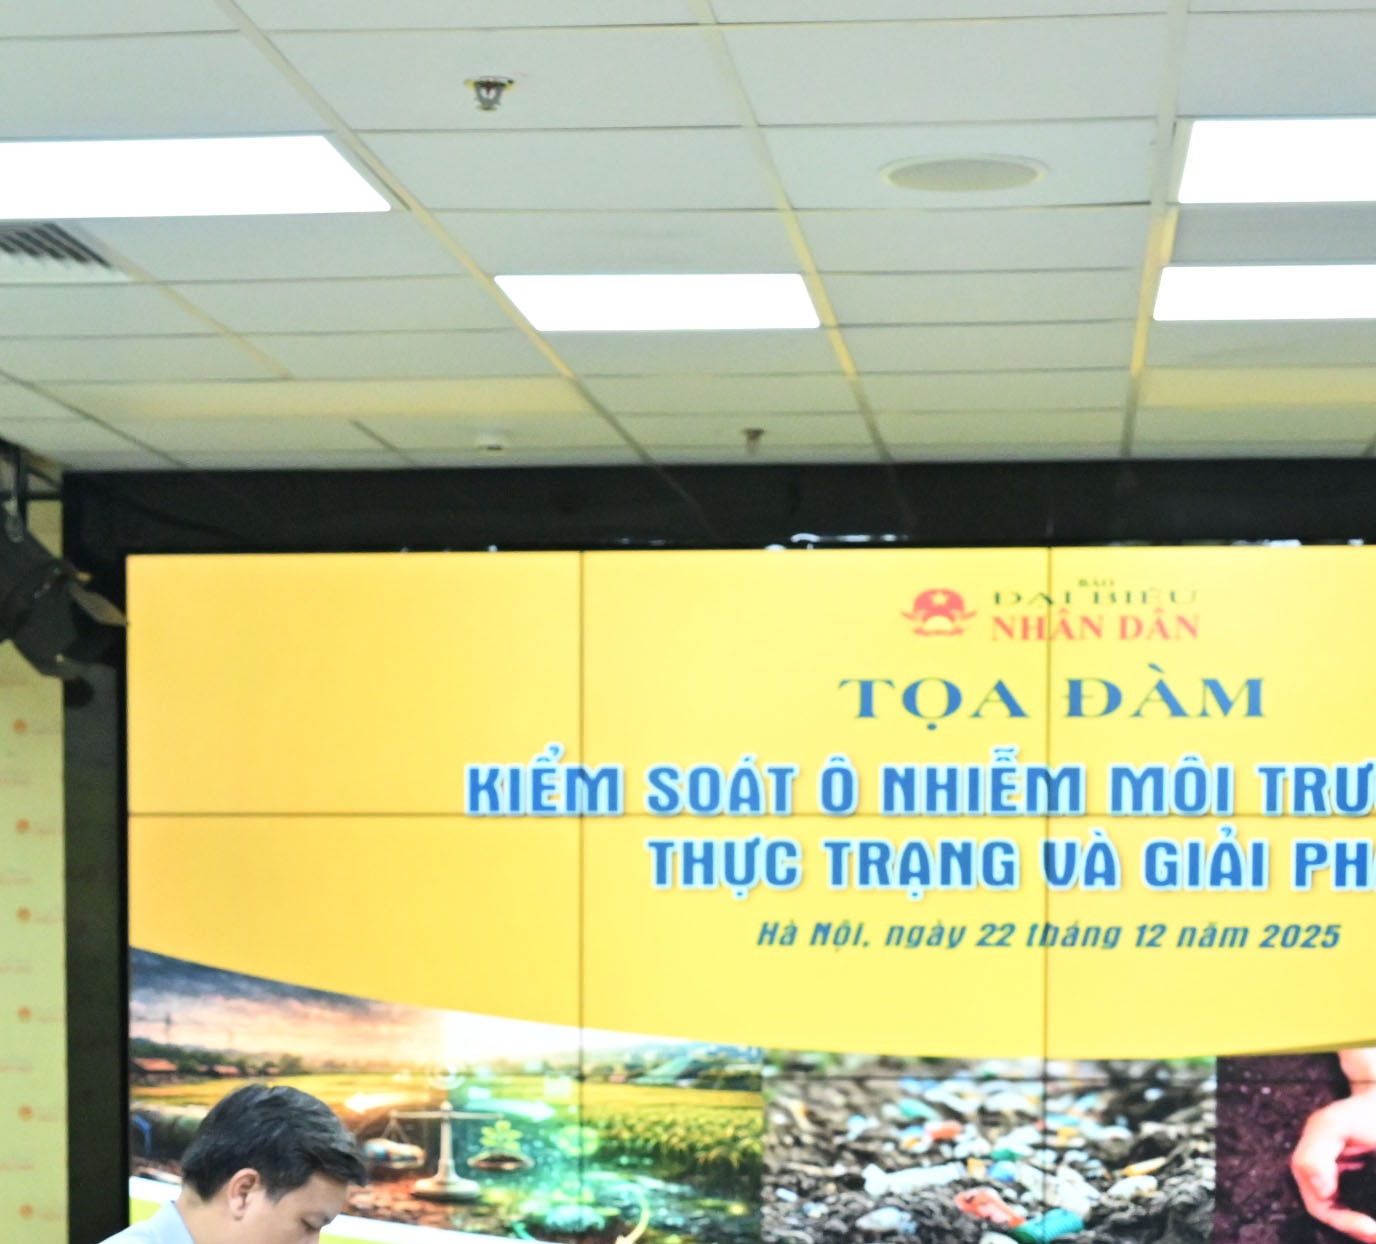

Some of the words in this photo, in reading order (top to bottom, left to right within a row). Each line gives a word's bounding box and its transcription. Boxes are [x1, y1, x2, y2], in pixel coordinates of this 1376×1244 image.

[991, 607, 1104, 642] NHÂN
[1118, 607, 1201, 642] DÂN
[838, 677, 1030, 731] TỌA
[1062, 662, 1266, 719] ĐÀM
[467, 743, 622, 815] KIỂM
[647, 755, 797, 814] SOÁT
[821, 755, 856, 814] Ô
[881, 746, 1084, 814] NHIỄM
[1109, 754, 1232, 814] MÔI
[646, 836, 800, 899] THỰC
[823, 839, 1019, 899] TRẠNG
[1041, 829, 1120, 889] VÀ
[1144, 825, 1268, 889] GIẢI
[756, 920, 798, 947] Hà
[884, 920, 965, 950] ngày
[976, 922, 1016, 947] 22
[1025, 920, 1122, 950] tháng
[1135, 923, 1165, 947] 12
[1177, 920, 1248, 948] năm
[1259, 923, 1340, 948] 2025
